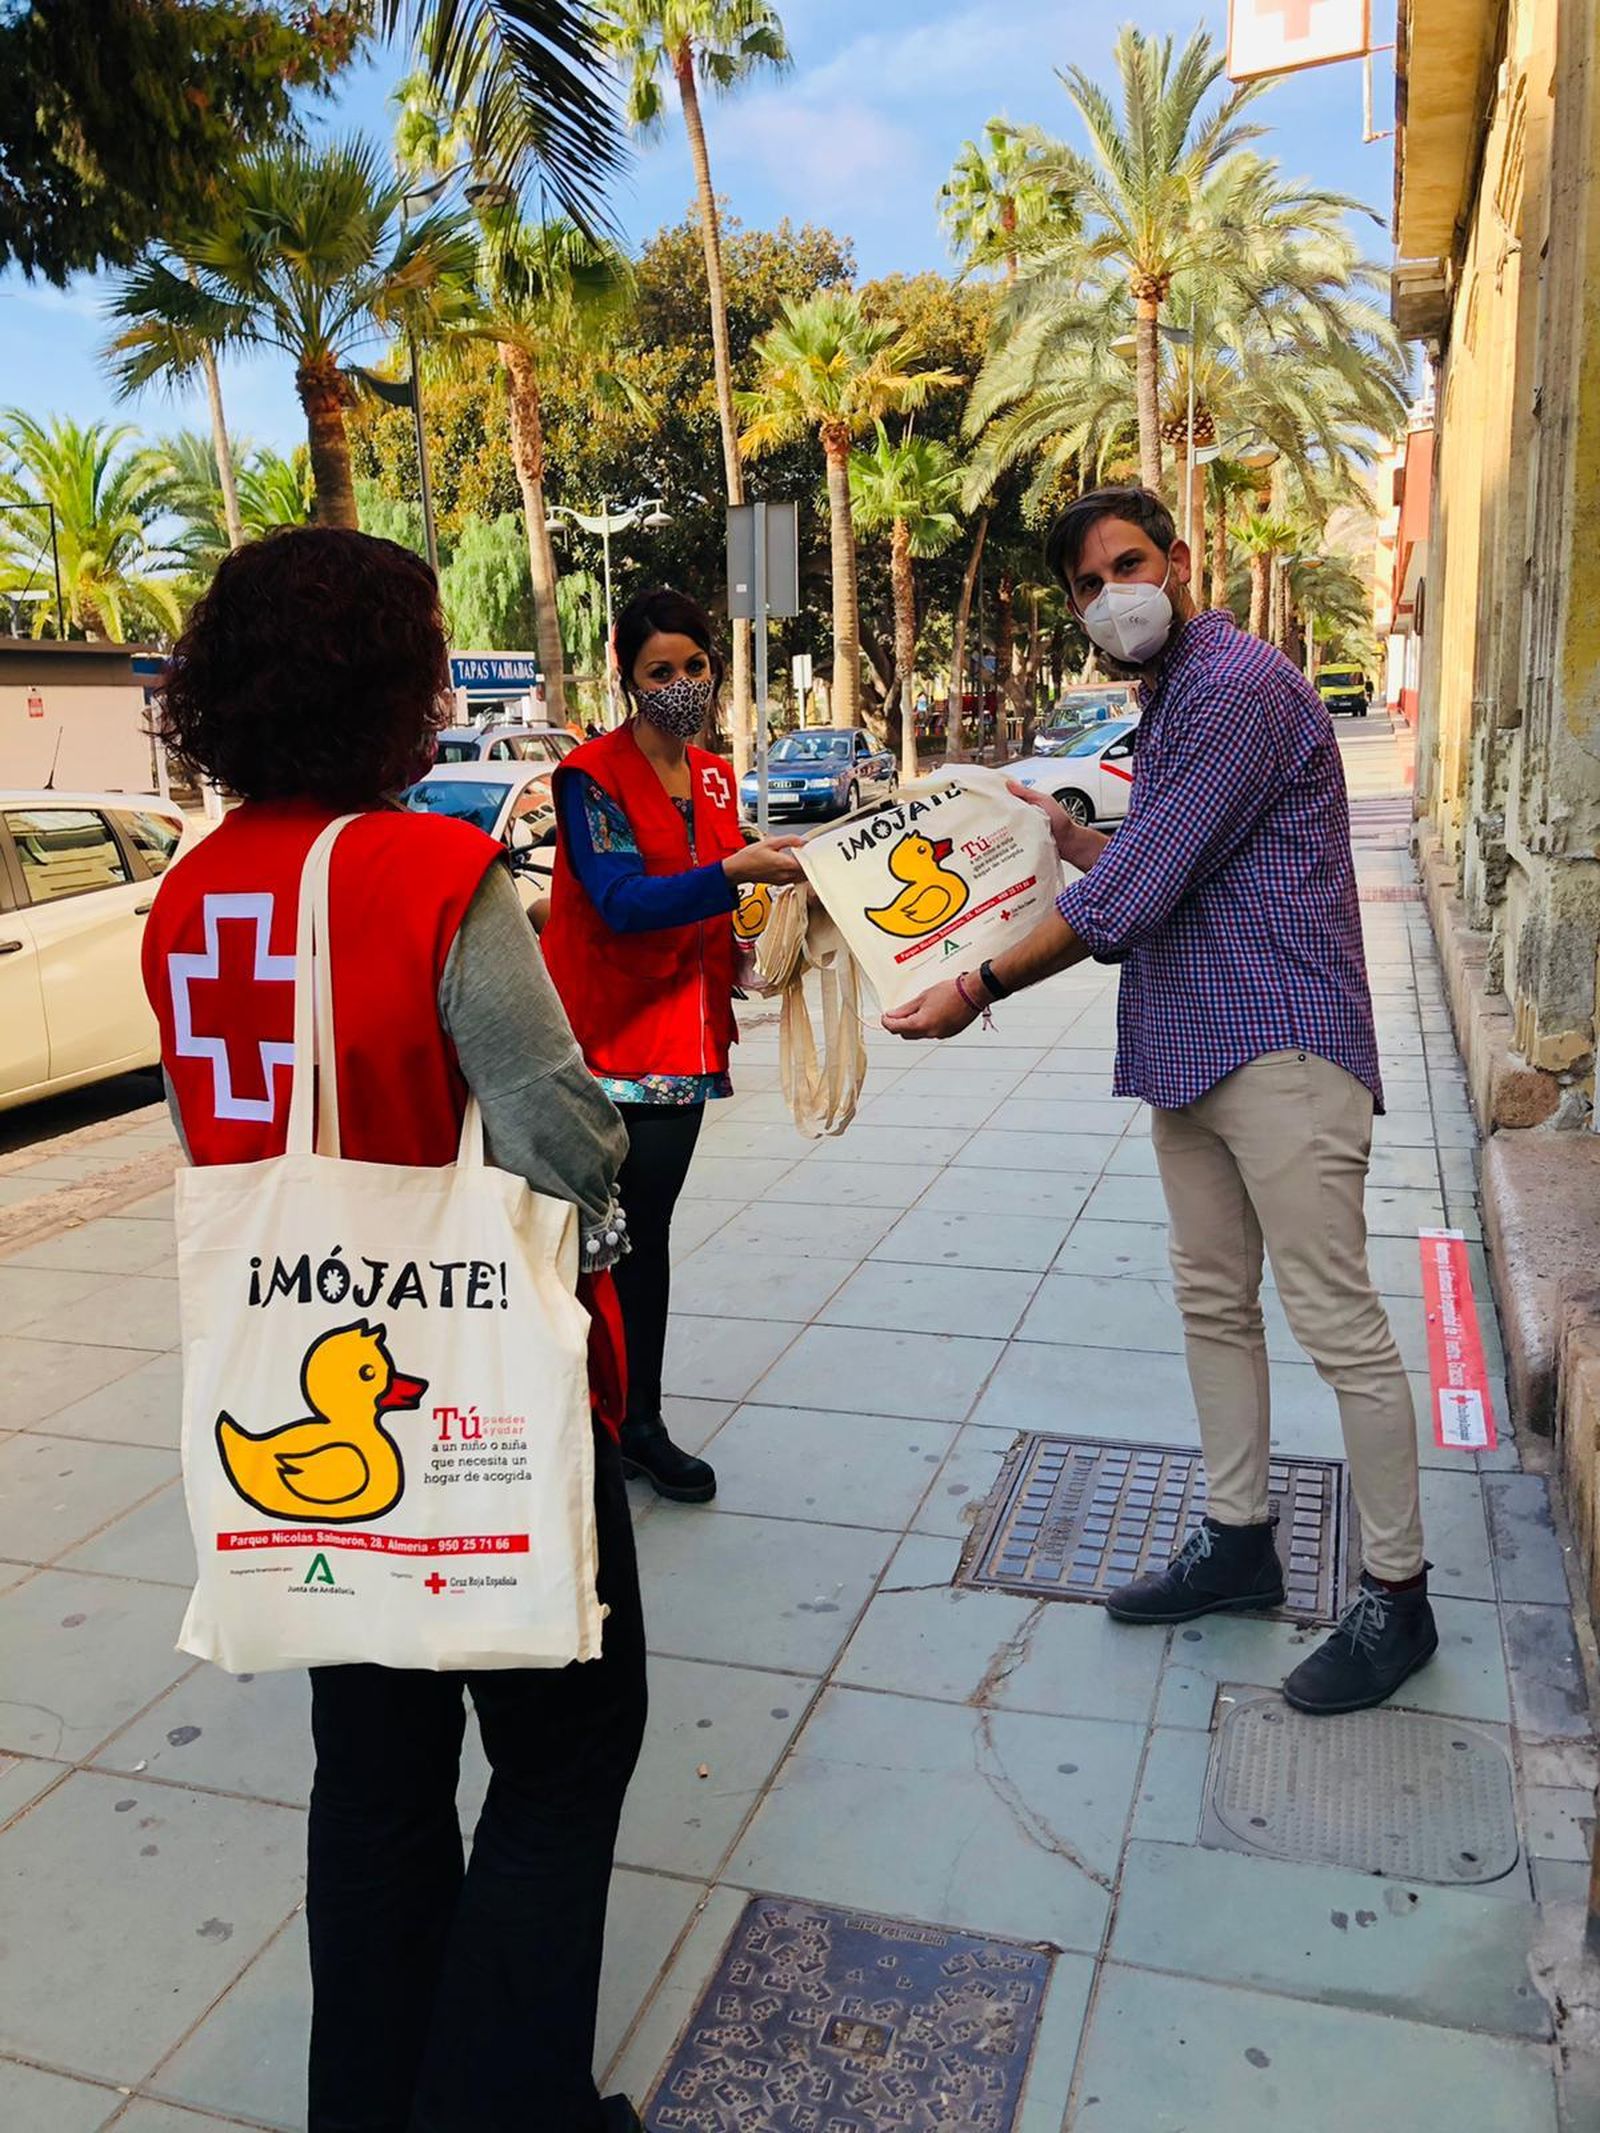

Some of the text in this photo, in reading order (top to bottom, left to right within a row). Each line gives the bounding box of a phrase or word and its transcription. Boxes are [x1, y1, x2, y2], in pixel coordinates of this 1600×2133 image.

[457, 660, 535, 680] TAPAS VARIADAS
[960, 836, 991, 859] Tú
[248, 1244, 508, 1310] ¡MÓJATE!
[432, 1406, 482, 1440] Tú
[483, 1415, 526, 1426] puedes
[483, 1426, 524, 1437] ayudar
[431, 1440, 527, 1452] a un niño o niña
[431, 1456, 528, 1471] que necesita un
[424, 1469, 532, 1486] hogar de acogida
[230, 1535, 269, 1547] Parque
[272, 1531, 313, 1544] Nicolás
[438, 1538, 460, 1552] 950
[462, 1538, 477, 1551] 25
[479, 1537, 493, 1550] 71
[495, 1537, 510, 1550] 66
[288, 1585, 308, 1593] Junta
[309, 1585, 318, 1594] de
[450, 1575, 518, 1588] Cruz Roja Española
